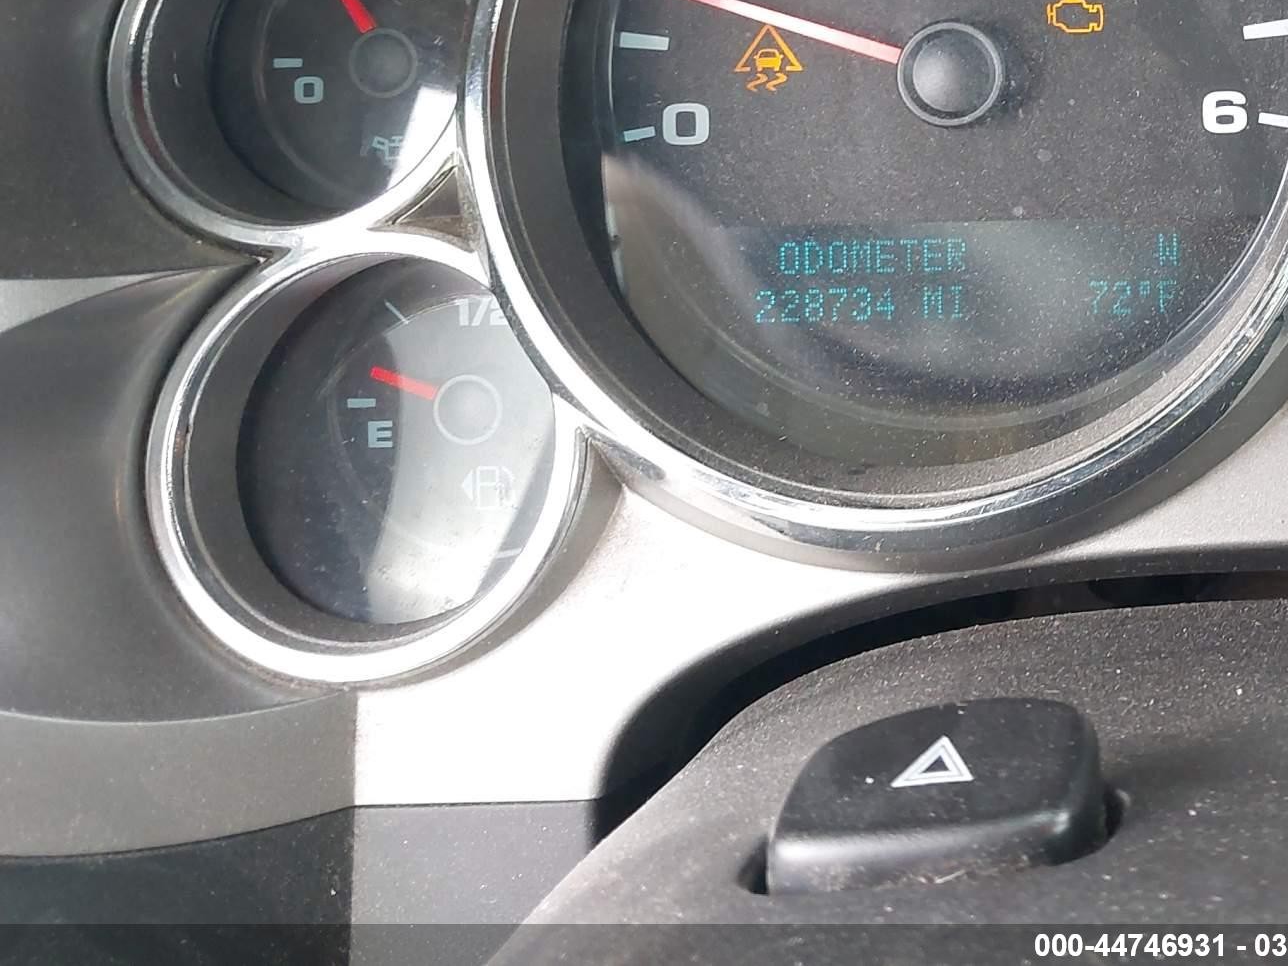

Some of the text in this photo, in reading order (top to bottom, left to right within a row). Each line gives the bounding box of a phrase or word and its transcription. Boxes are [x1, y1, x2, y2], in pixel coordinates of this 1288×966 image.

[294, 76, 324, 105] 0
[662, 102, 709, 144] 0
[1201, 91, 1248, 133] 6
[779, 238, 966, 275] ODOMETER
[1158, 233, 1178, 267] W
[755, 285, 963, 324] 228734 MI
[367, 420, 393, 448] E
